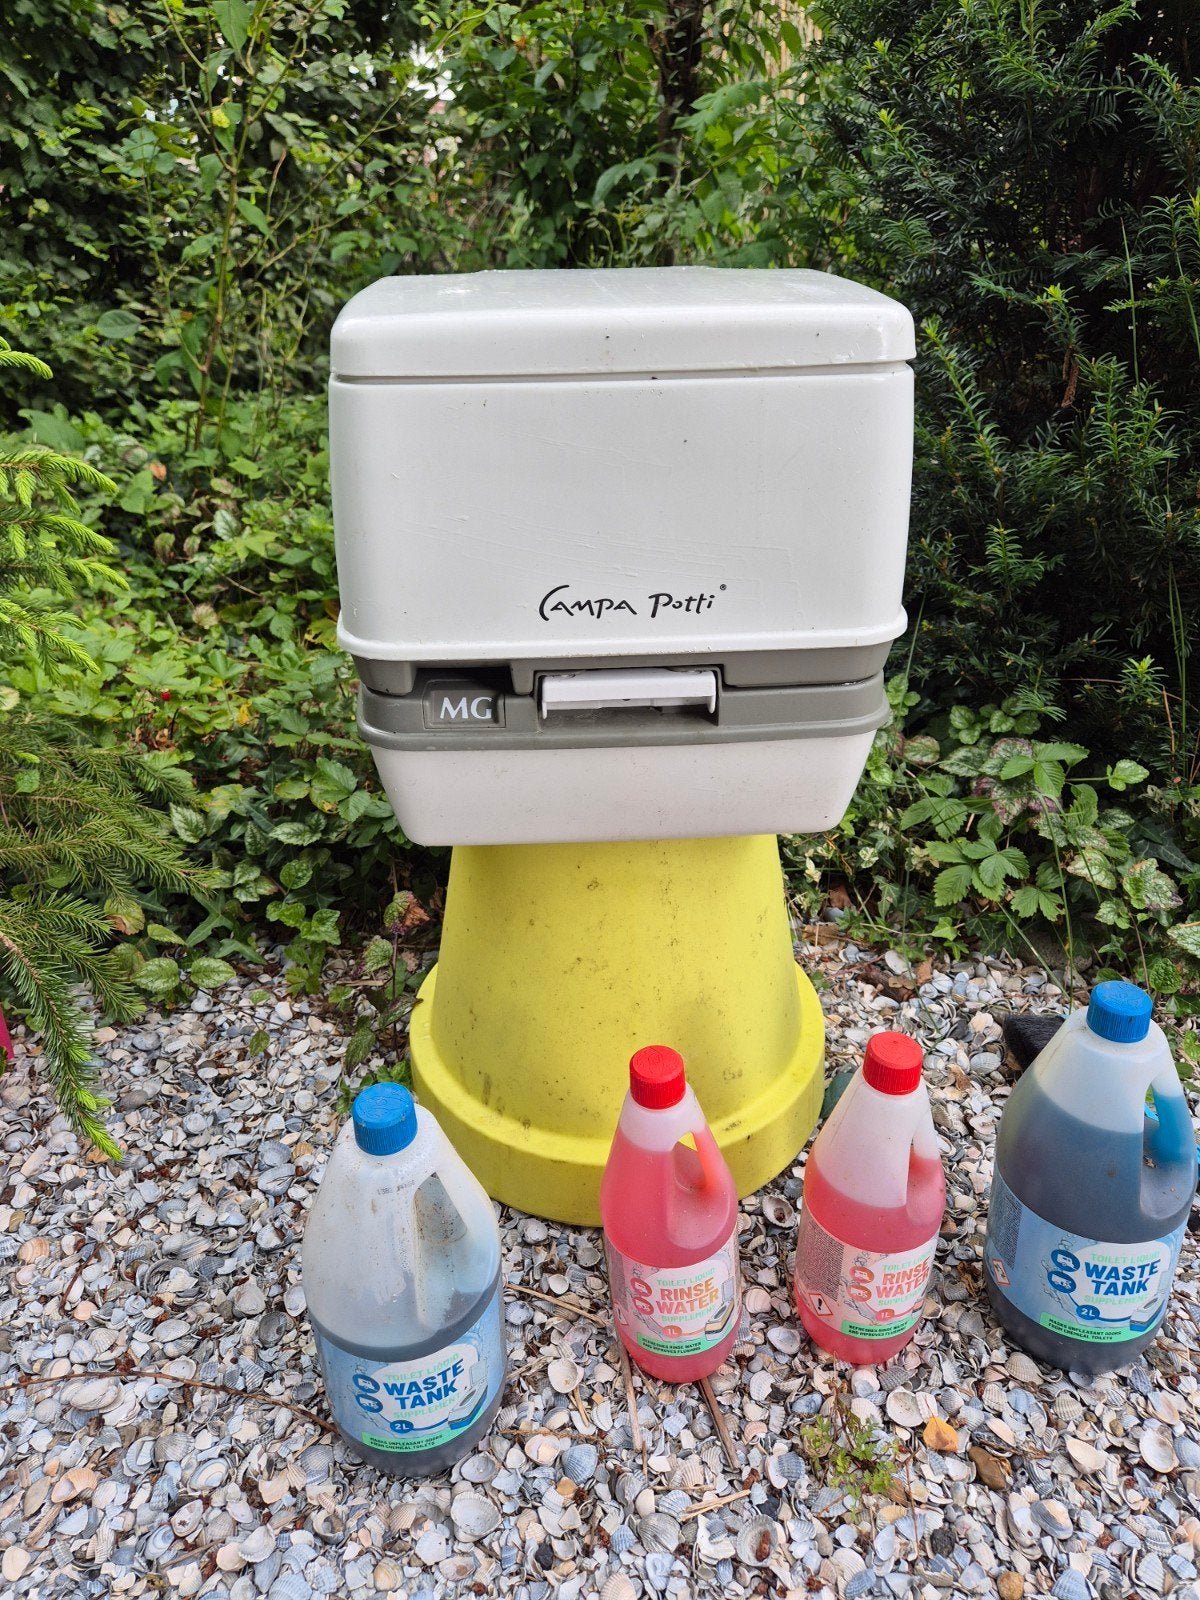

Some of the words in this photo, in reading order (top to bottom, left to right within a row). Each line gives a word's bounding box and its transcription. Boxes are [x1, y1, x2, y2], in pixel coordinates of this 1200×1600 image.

[439, 696, 493, 720] MG
[1091, 1253, 1127, 1264] TOILET
[1130, 1251, 1160, 1264] LIQUID
[882, 1256, 931, 1286] RINSE
[1084, 1259, 1161, 1281] WASTE
[657, 1278, 688, 1288] TOILET
[660, 1276, 715, 1302] RINSE
[876, 1266, 930, 1299] WATER
[1091, 1278, 1150, 1296] TANK
[655, 1288, 719, 1315] WATER
[1083, 1294, 1149, 1306] SUPPLEMENT
[1049, 1318, 1067, 1329] MASKS
[1081, 1308, 1096, 1317] 2L
[667, 1328, 679, 1336] 1L
[382, 1358, 465, 1397] WASTE
[385, 1369, 423, 1383] TOILET
[394, 1378, 458, 1410] TANK
[393, 1392, 460, 1419] SUPPLEMENT
